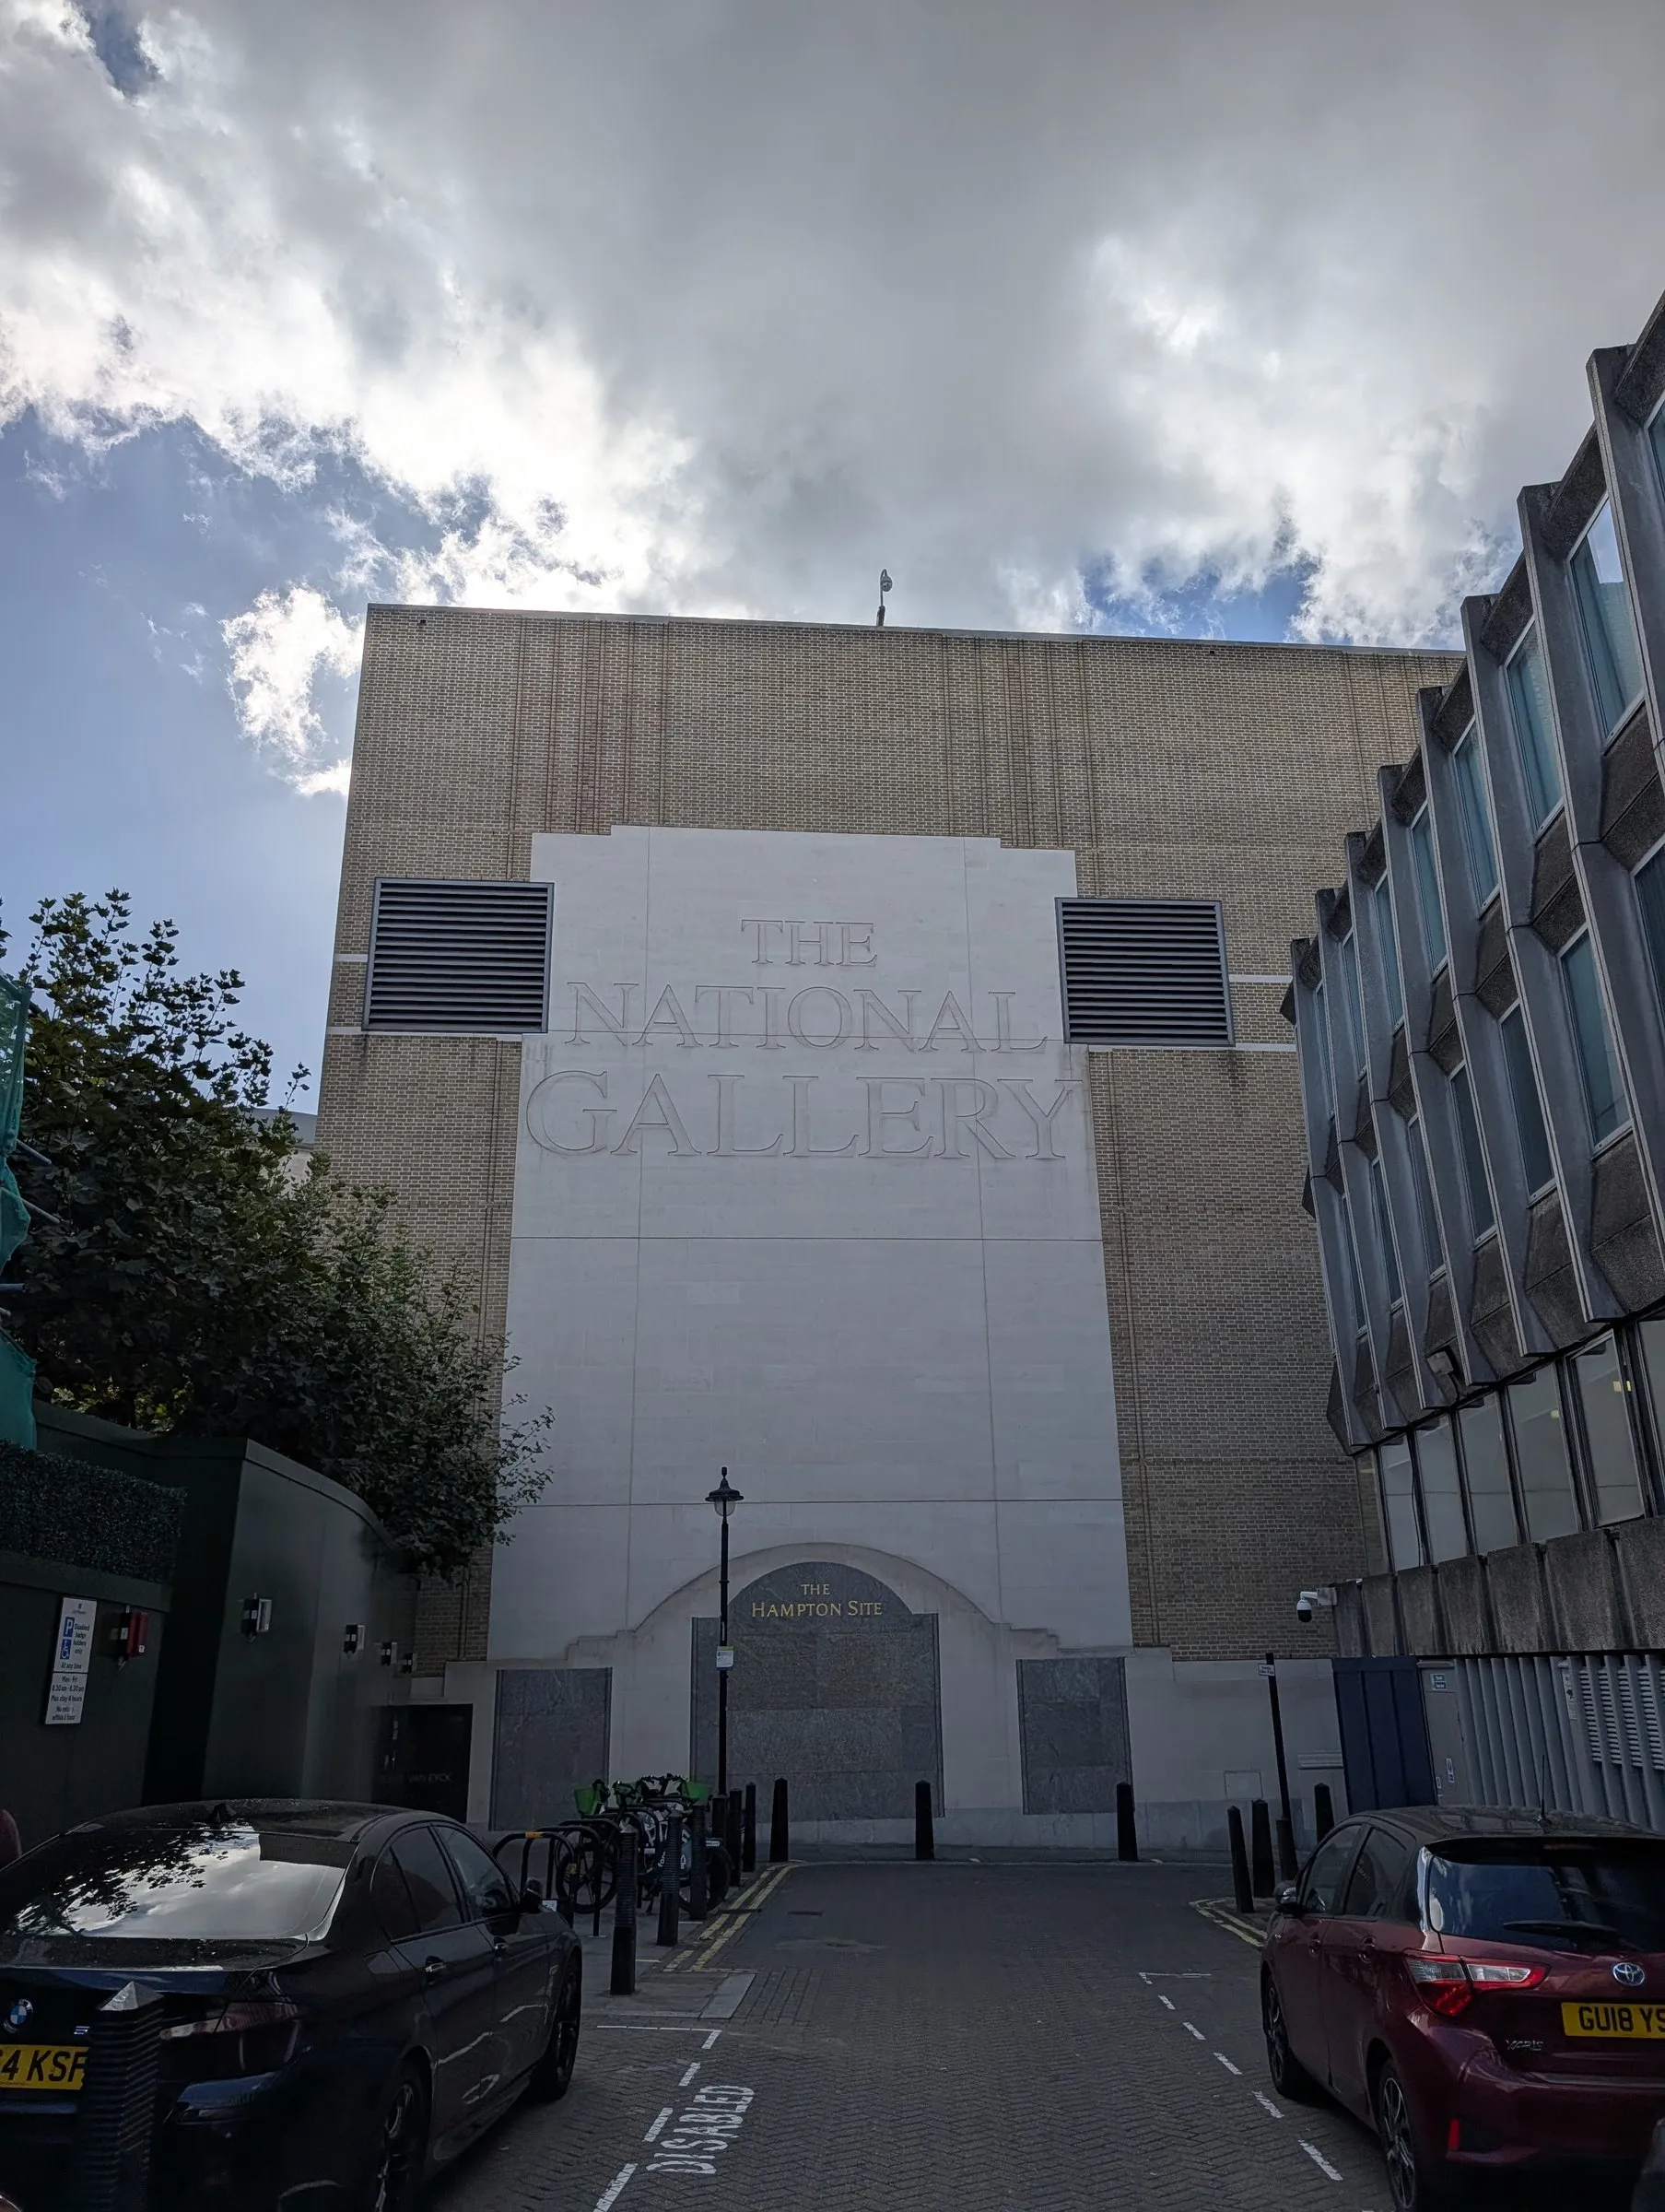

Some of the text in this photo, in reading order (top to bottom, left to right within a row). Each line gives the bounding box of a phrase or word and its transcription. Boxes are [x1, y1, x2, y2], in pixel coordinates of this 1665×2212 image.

[741, 919, 878, 967] THE
[563, 982, 1049, 1053] NATIONAL
[525, 1069, 1084, 1159] GALLERY
[801, 1583, 830, 1595] THE
[751, 1600, 883, 1618] HAMPTON SITE
[64, 1618, 74, 1635] P
[74, 1623, 90, 1631] Disabled
[1578, 2006, 1635, 2032] GU18
[0, 2049, 21, 2081] 4
[646, 2085, 756, 2174] DISABLED
